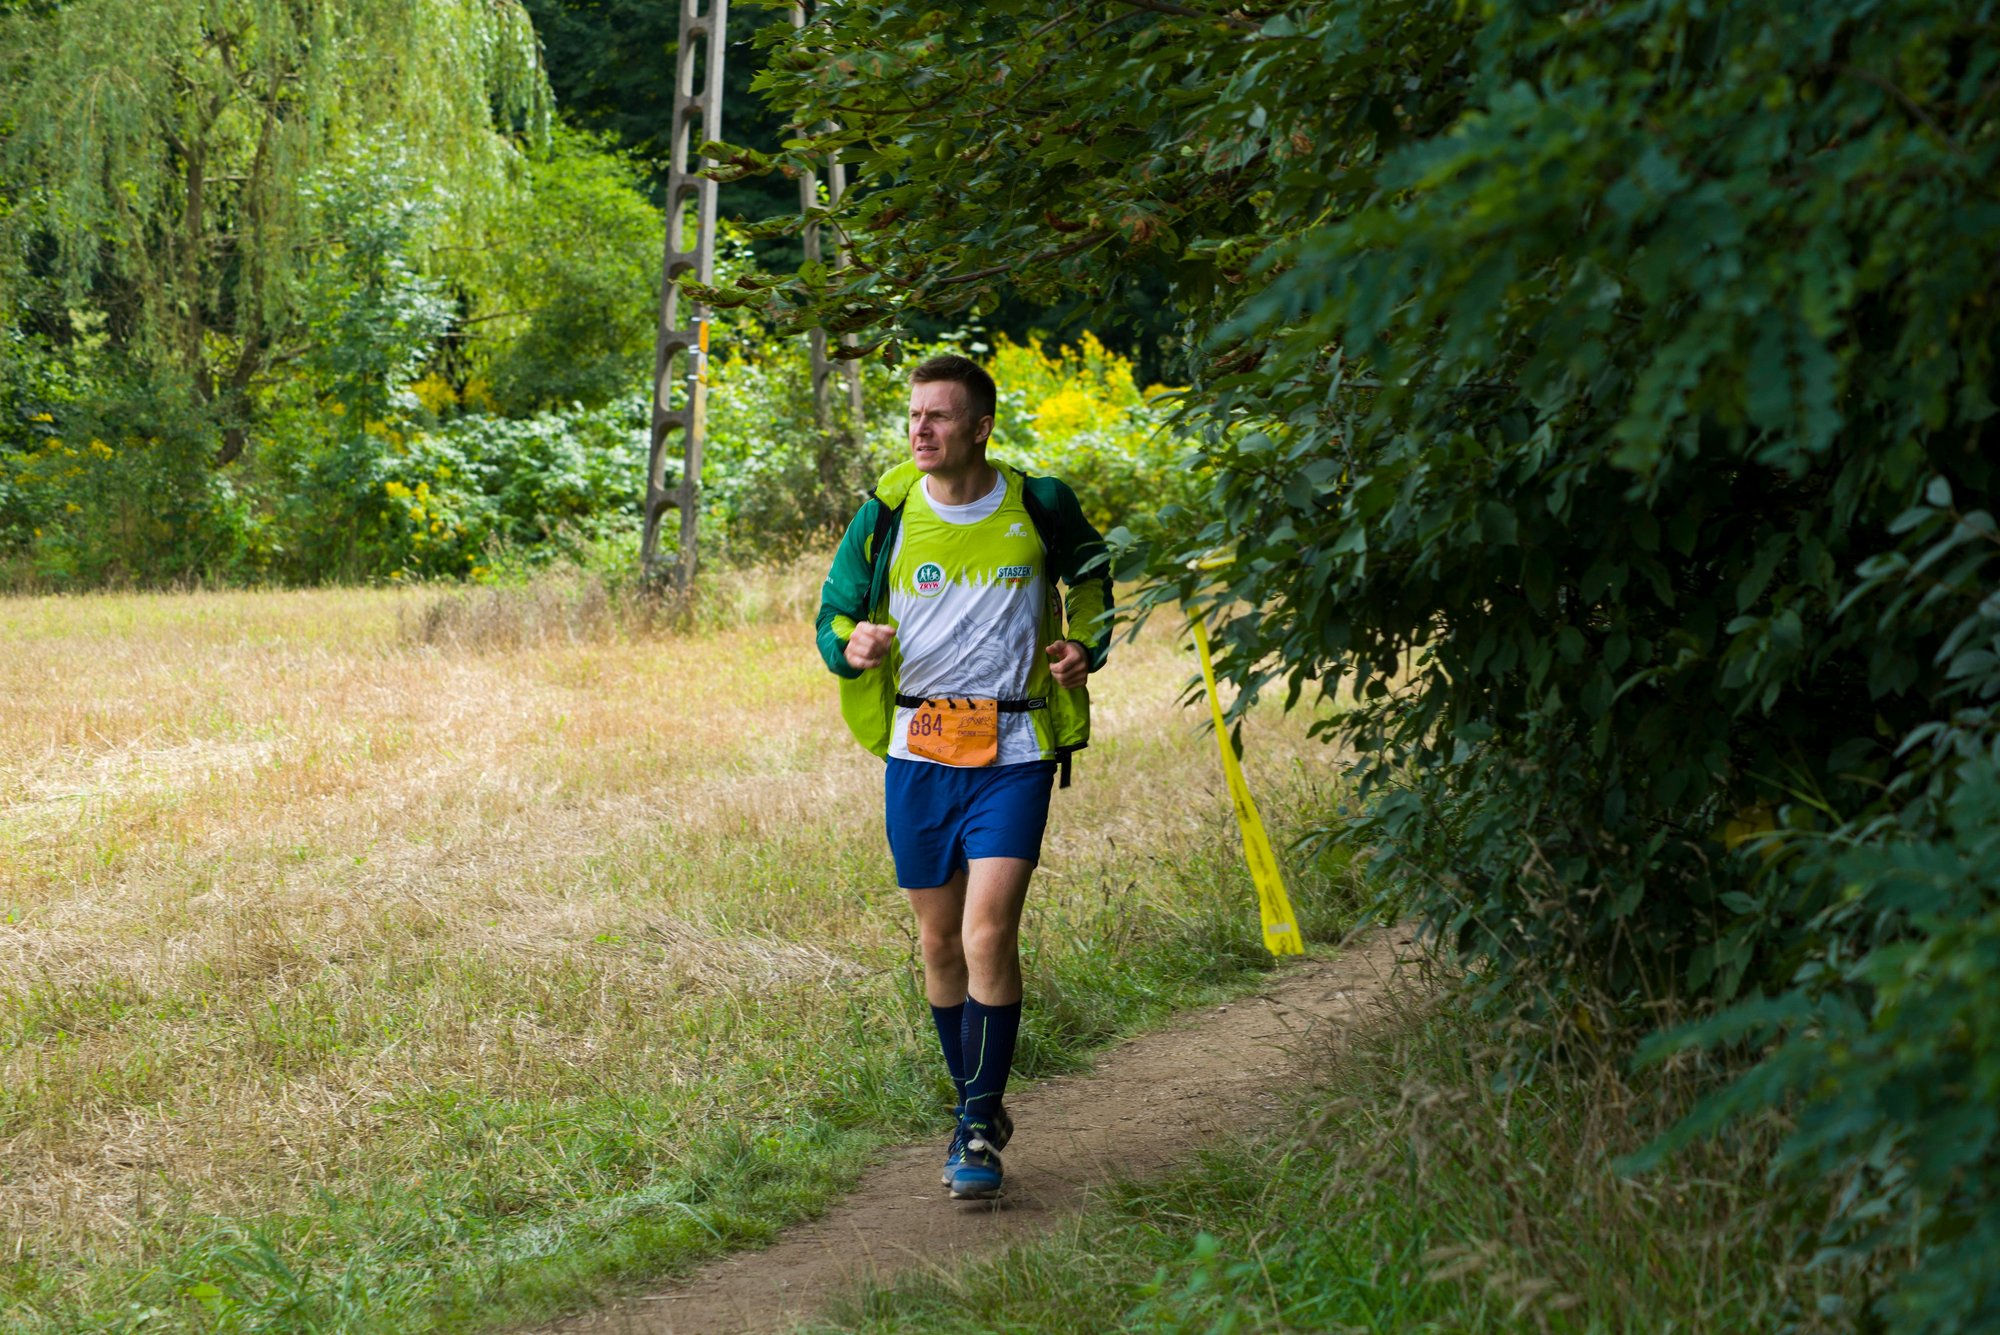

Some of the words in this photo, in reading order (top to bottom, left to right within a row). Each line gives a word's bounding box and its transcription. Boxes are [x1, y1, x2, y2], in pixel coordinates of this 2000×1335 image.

[998, 566, 1032, 578] STASZEK
[919, 582, 939, 590] ZRYW
[910, 713, 943, 737] 684
